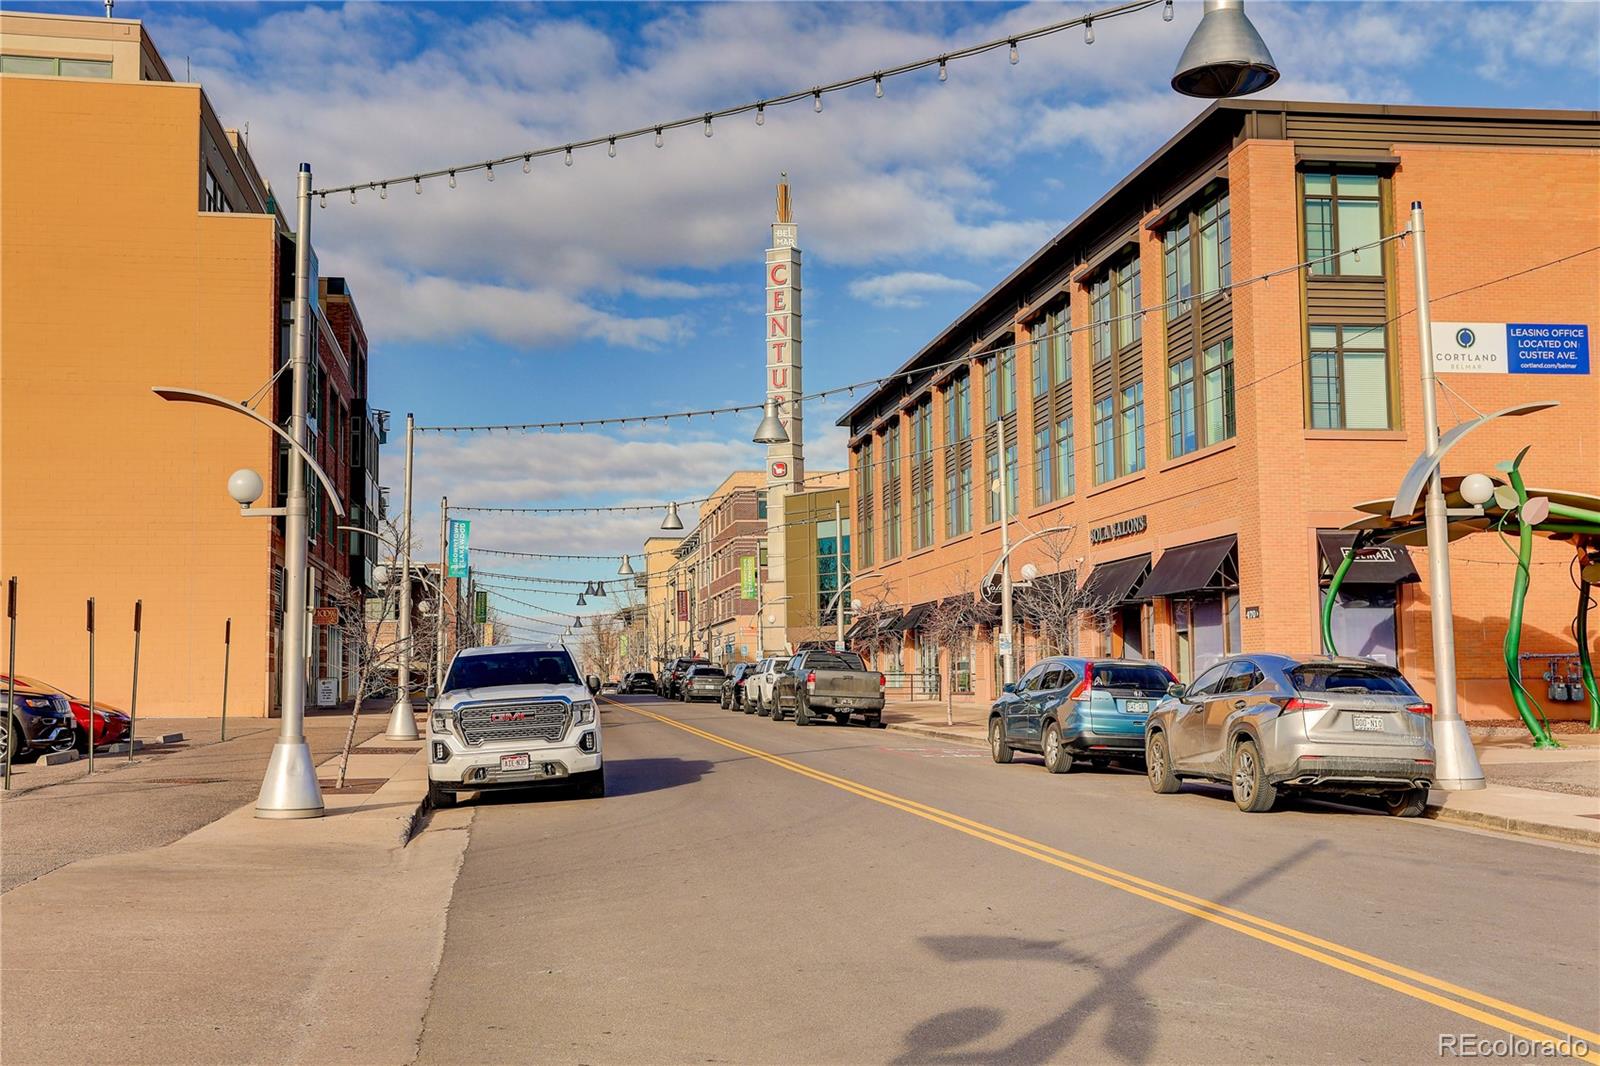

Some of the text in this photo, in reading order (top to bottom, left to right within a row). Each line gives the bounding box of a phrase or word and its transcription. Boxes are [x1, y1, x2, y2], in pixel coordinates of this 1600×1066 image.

[776, 227, 793, 238] BEL
[776, 238, 796, 248] MAR
[1510, 328, 1585, 338] LEASING OFFICE
[770, 263, 789, 428] CENTU
[1518, 340, 1578, 349] LOCATED ON
[1436, 353, 1497, 362] CORTLAND
[1519, 351, 1578, 360] CUSTER AVE.
[1520, 362, 1577, 370] cortland.com/belmar
[1089, 514, 1148, 544] SOLA SALONS
[491, 711, 535, 722] GMC
